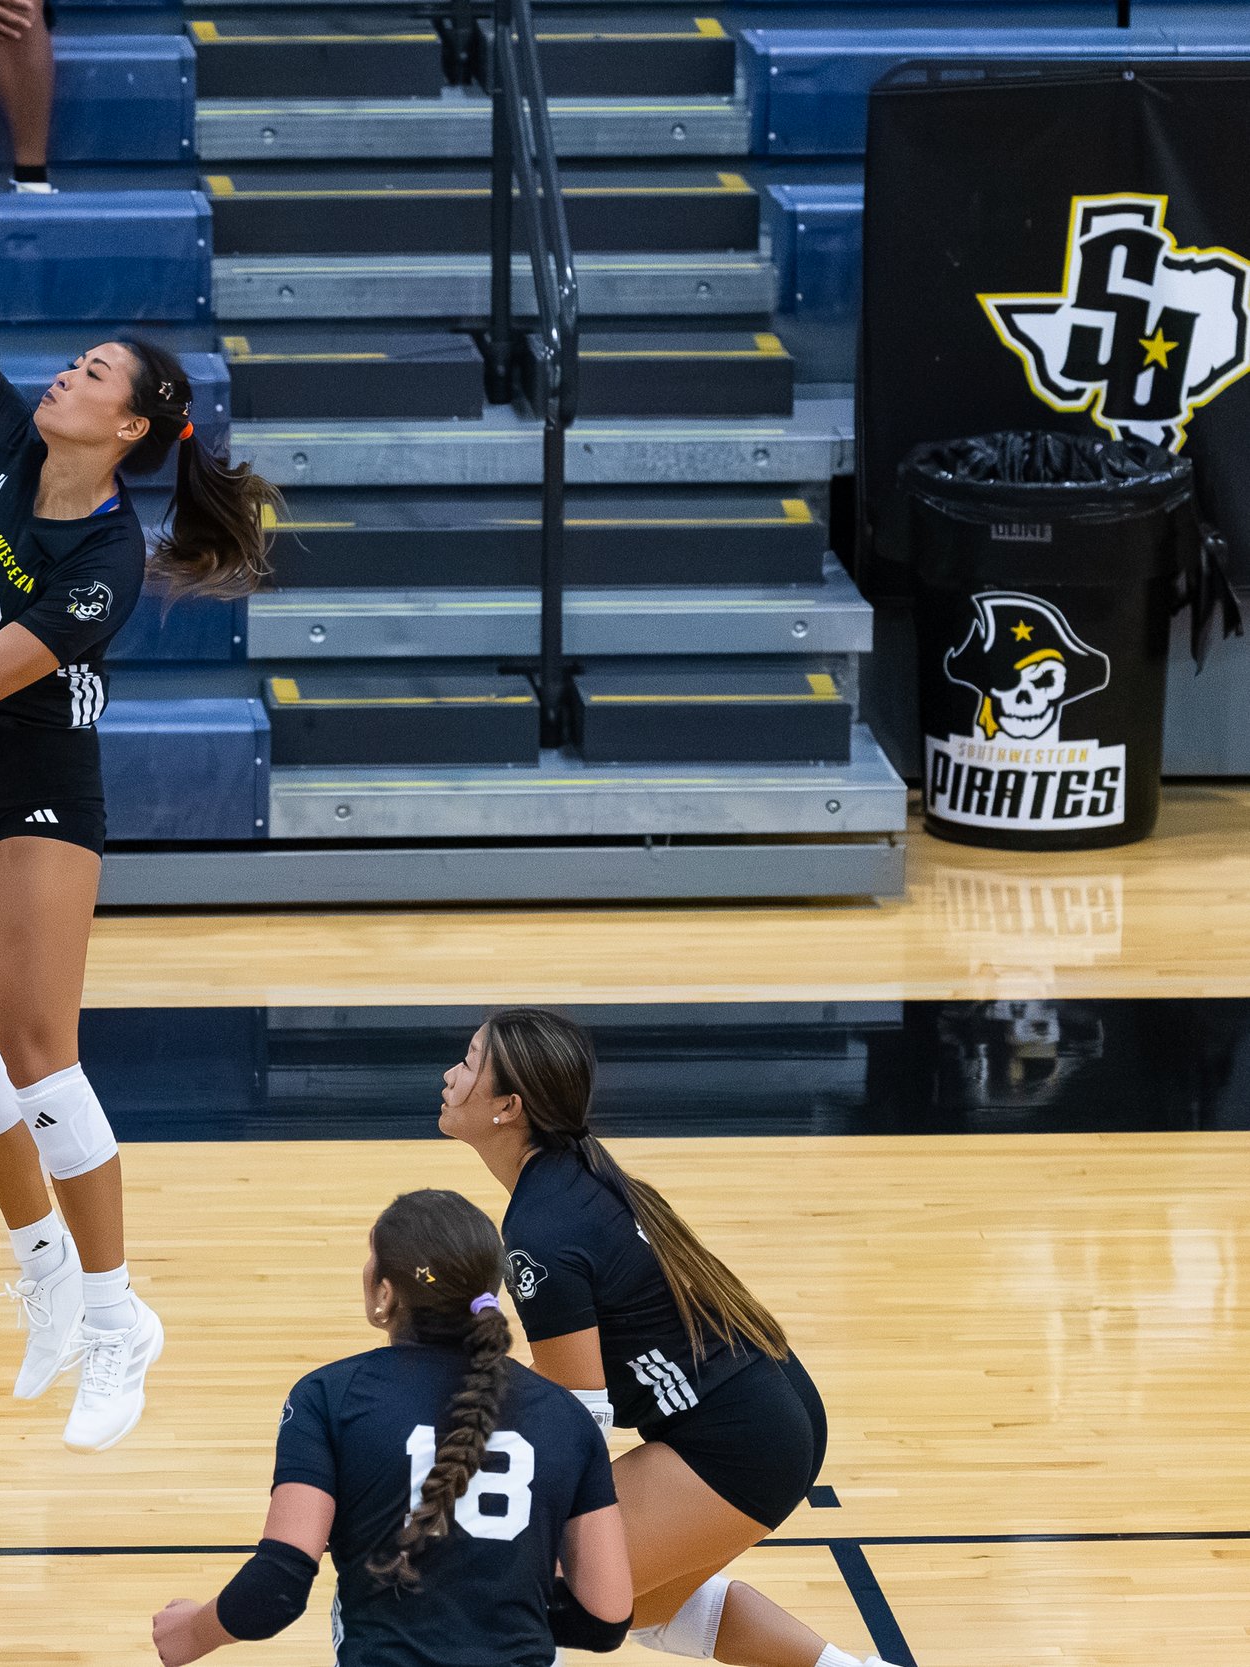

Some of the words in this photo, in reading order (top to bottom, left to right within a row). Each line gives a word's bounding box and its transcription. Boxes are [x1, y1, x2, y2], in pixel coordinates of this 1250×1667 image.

[930, 749, 1122, 820] PIRATES
[957, 742, 1090, 765] SOUTHWESTERN
[403, 1423, 535, 1542] 18
